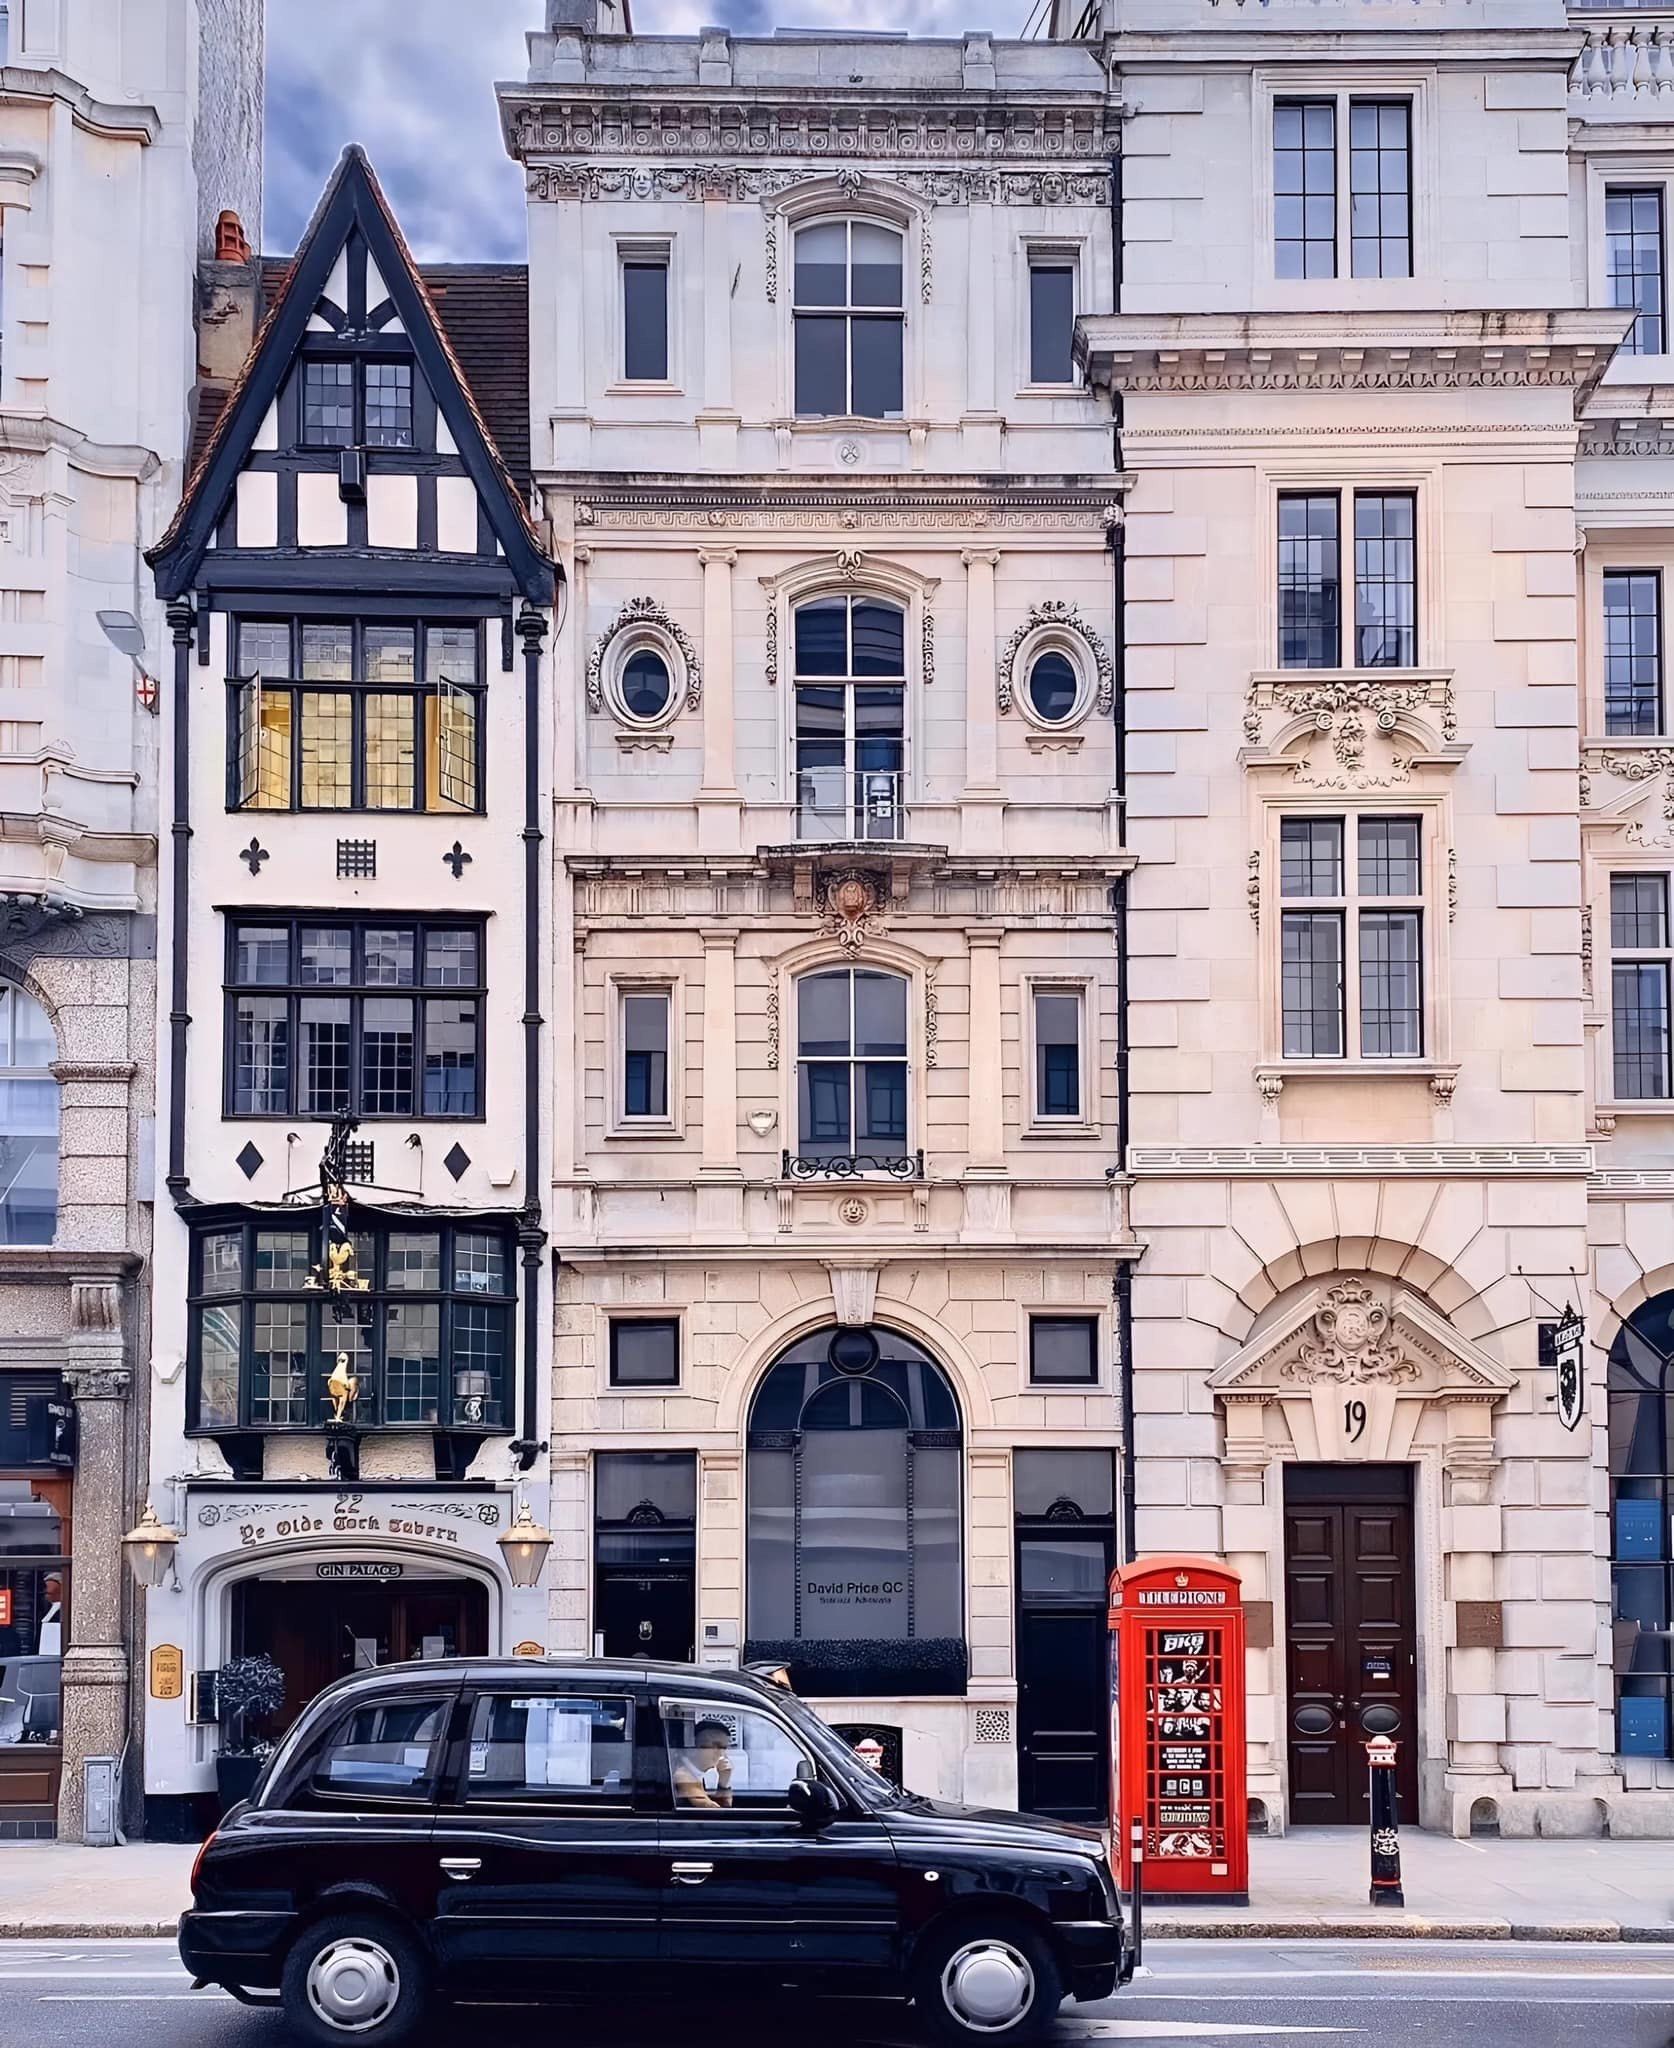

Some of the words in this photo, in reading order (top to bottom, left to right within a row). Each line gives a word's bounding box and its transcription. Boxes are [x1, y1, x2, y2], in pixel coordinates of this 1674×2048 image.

[1344, 1400, 1367, 1443] 19
[334, 1492, 364, 1514] 22
[239, 1523, 266, 1547] Ye
[276, 1515, 324, 1536] Olde
[388, 1519, 458, 1543] Tavern
[320, 1564, 345, 1576] GIN
[349, 1564, 398, 1576] PALACE
[807, 1582, 843, 1594] David
[847, 1582, 879, 1594] Price
[882, 1582, 904, 1594] QC
[1139, 1591, 1226, 1604] TELEPHONE
